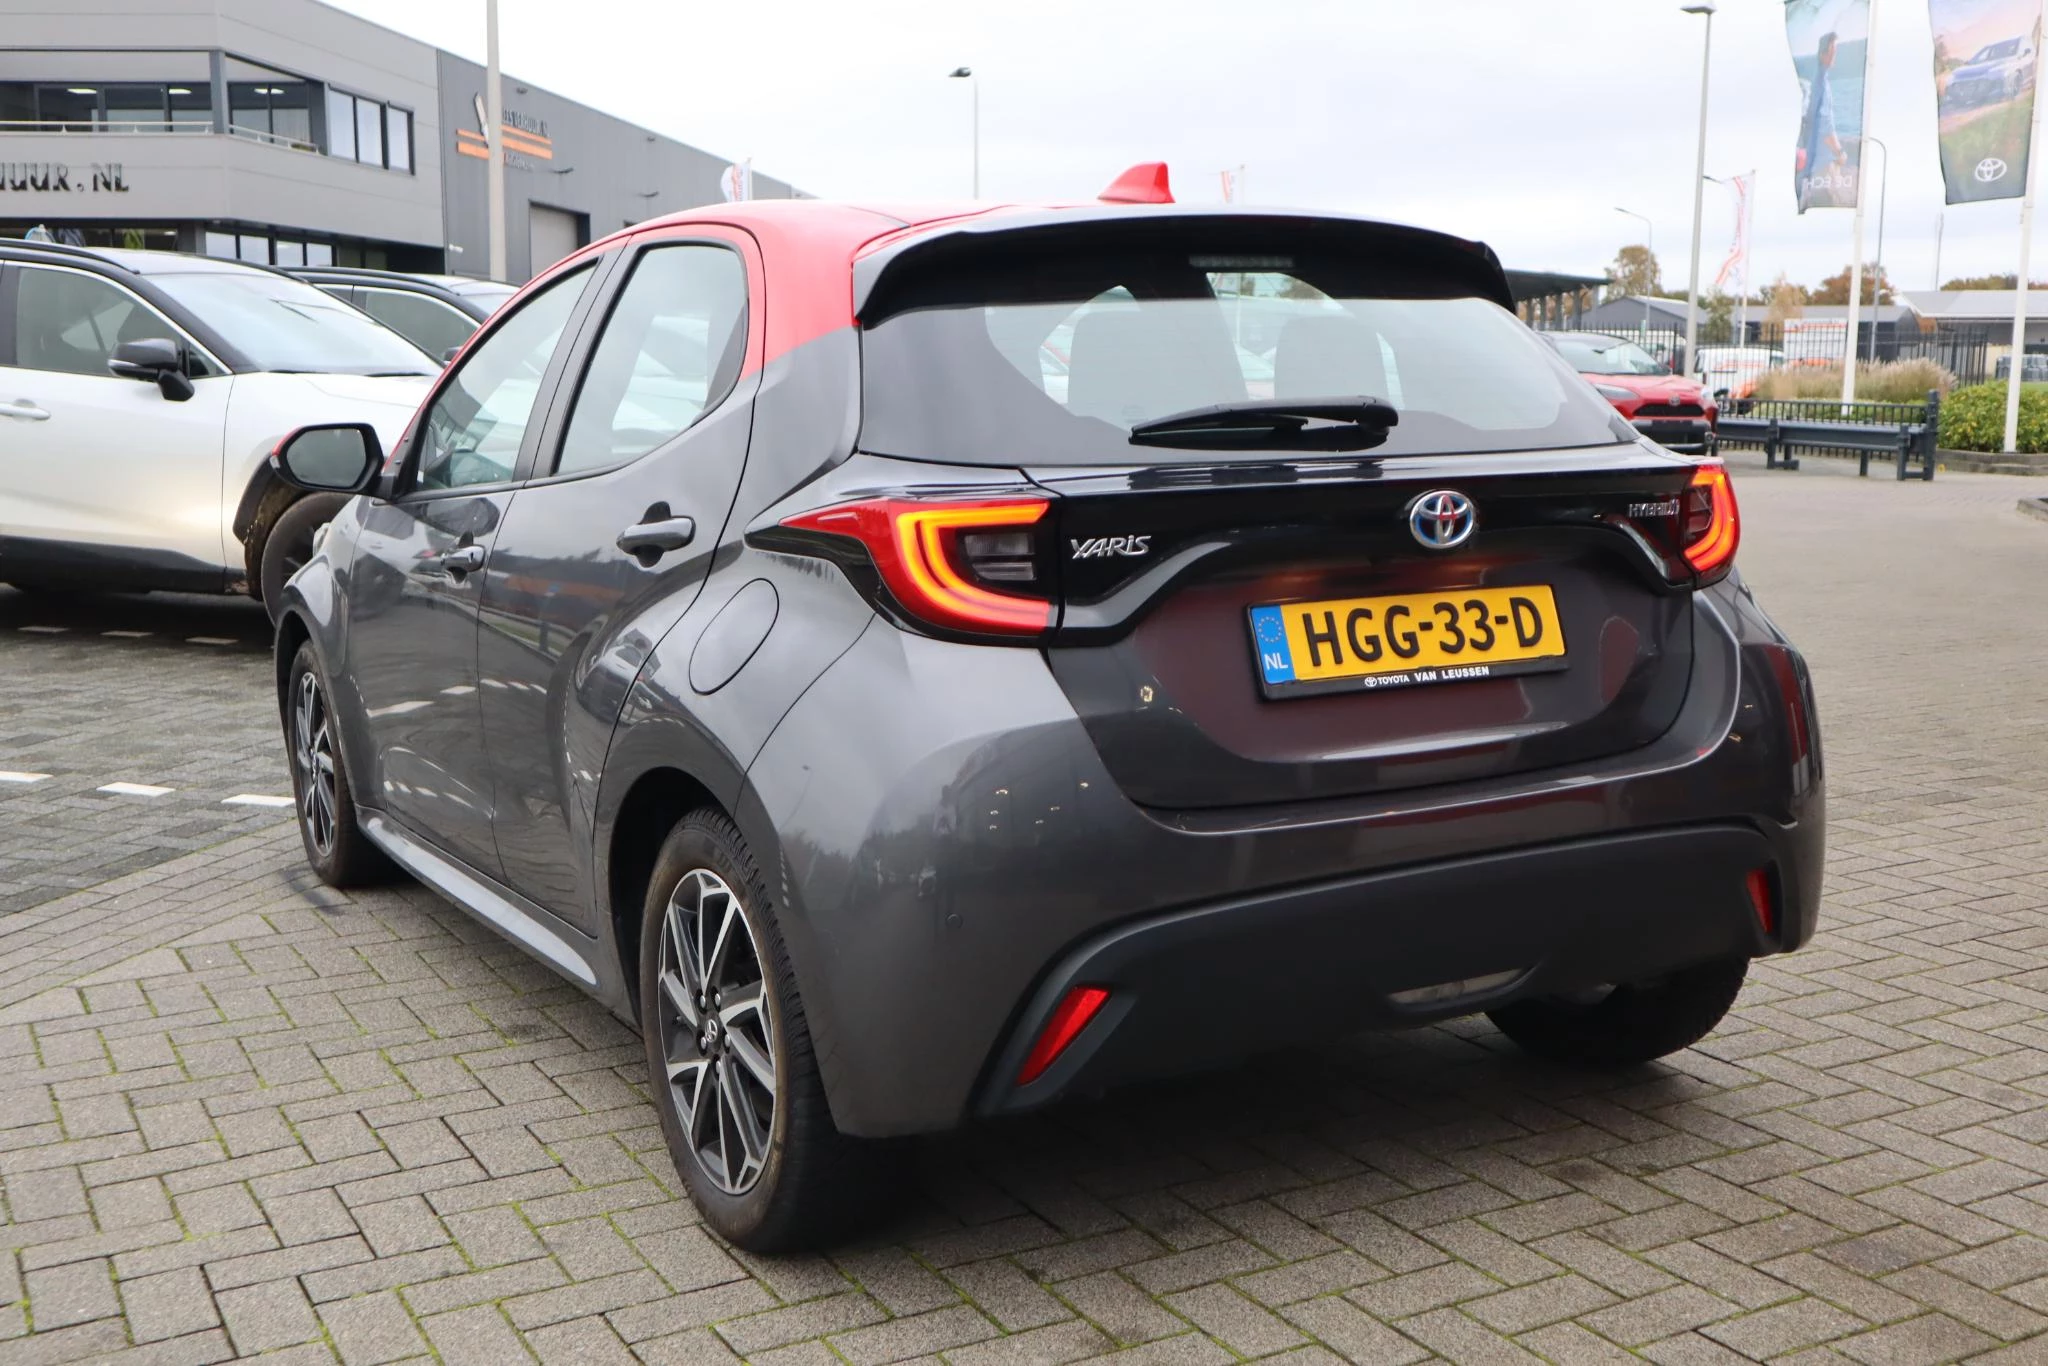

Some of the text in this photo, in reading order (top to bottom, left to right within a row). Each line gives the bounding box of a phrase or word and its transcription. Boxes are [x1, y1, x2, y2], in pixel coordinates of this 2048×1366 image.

[0, 162, 129, 192] UUR.NL
[1070, 534, 1151, 559] YARIS
[1302, 597, 1543, 667] HGG-33-D
[1264, 652, 1288, 671] NL
[1378, 666, 1490, 685] TOYOTA VAN LEUSSEN
